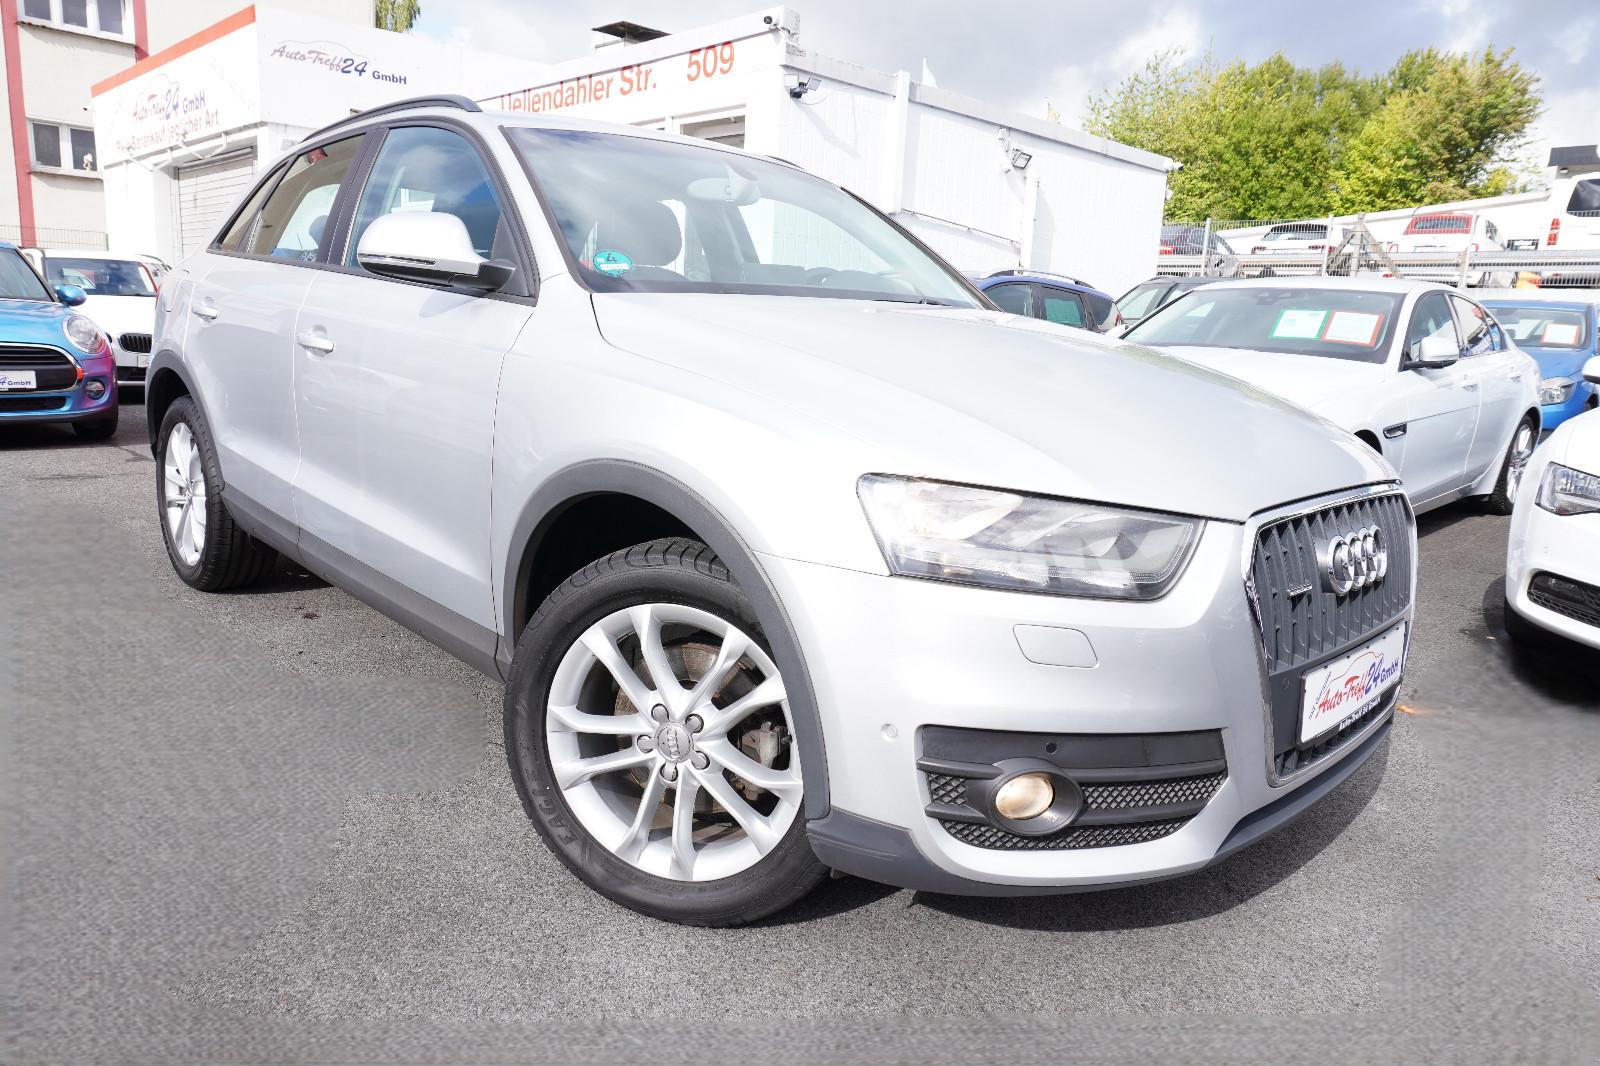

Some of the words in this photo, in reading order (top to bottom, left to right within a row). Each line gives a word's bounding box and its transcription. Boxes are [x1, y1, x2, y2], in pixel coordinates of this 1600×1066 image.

[372, 70, 407, 85] GmbH
[619, 64, 657, 96] Str.
[687, 41, 734, 81] 509
[183, 88, 206, 115] GmbH
[205, 109, 219, 127] Art
